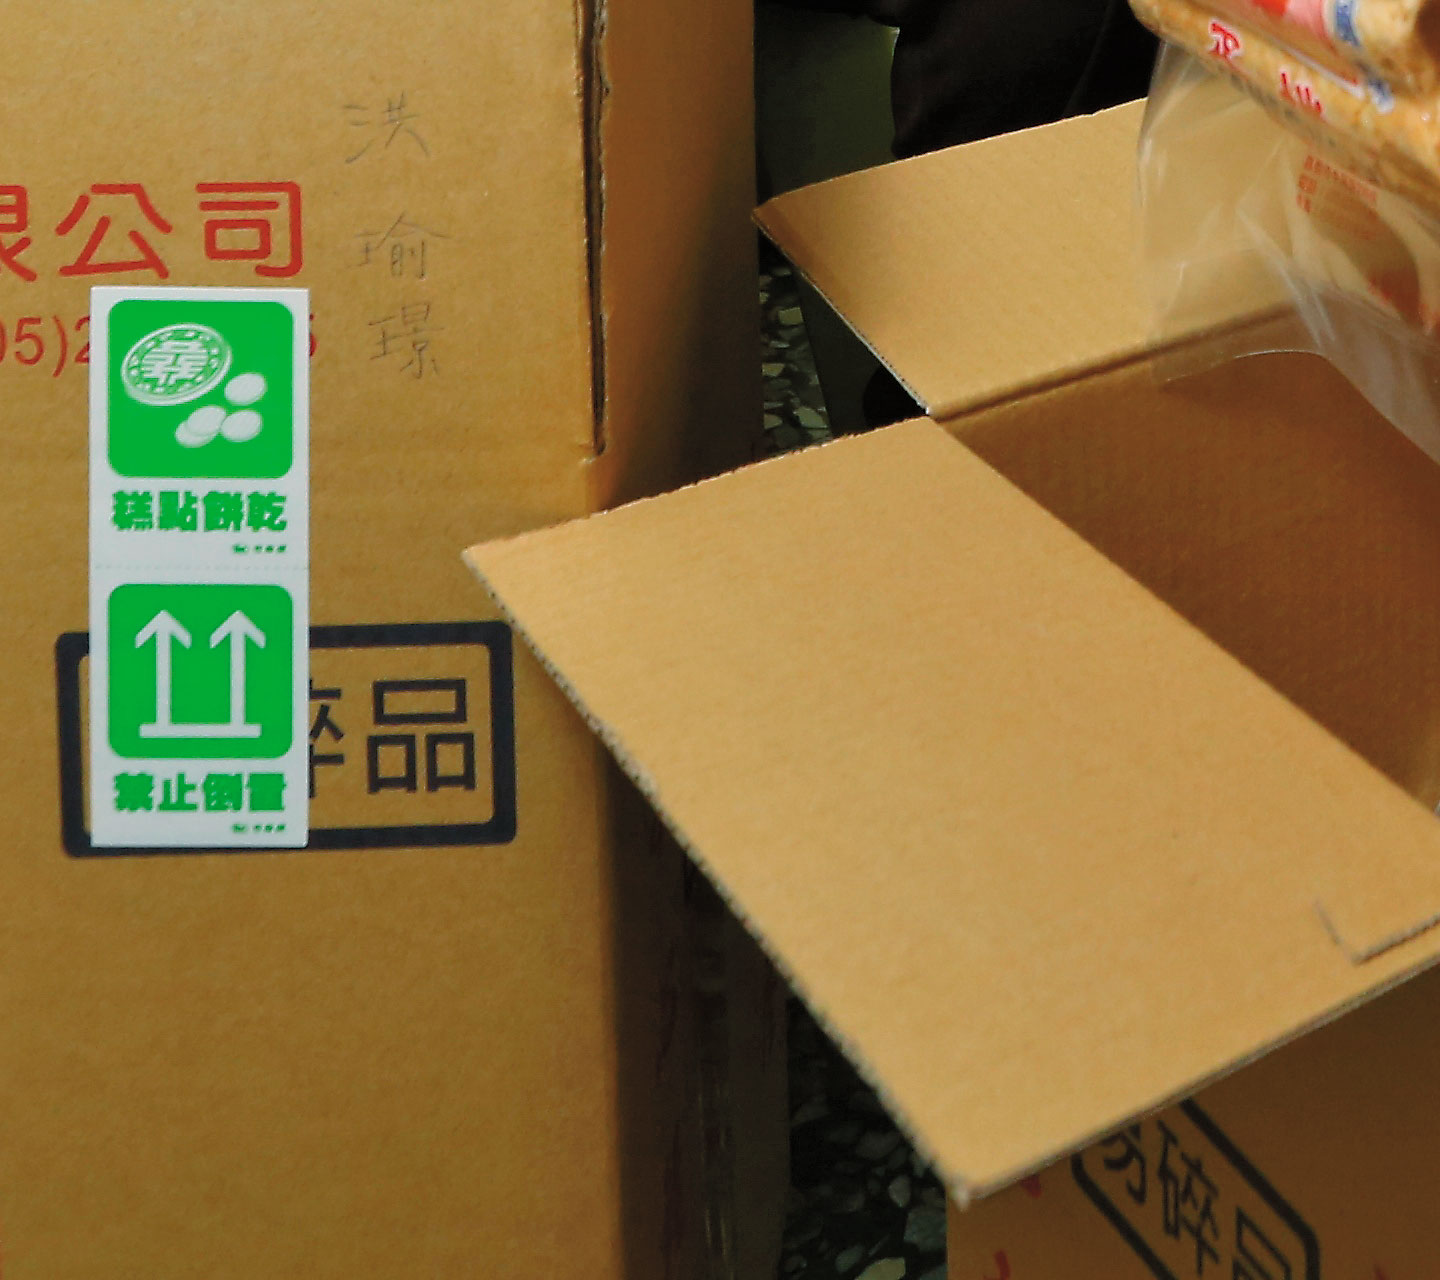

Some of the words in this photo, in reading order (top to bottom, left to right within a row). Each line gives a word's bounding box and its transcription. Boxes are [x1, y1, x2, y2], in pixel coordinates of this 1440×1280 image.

[112, 489, 289, 534] 糕點餅乾
[113, 772, 288, 814] 禁止倒置
